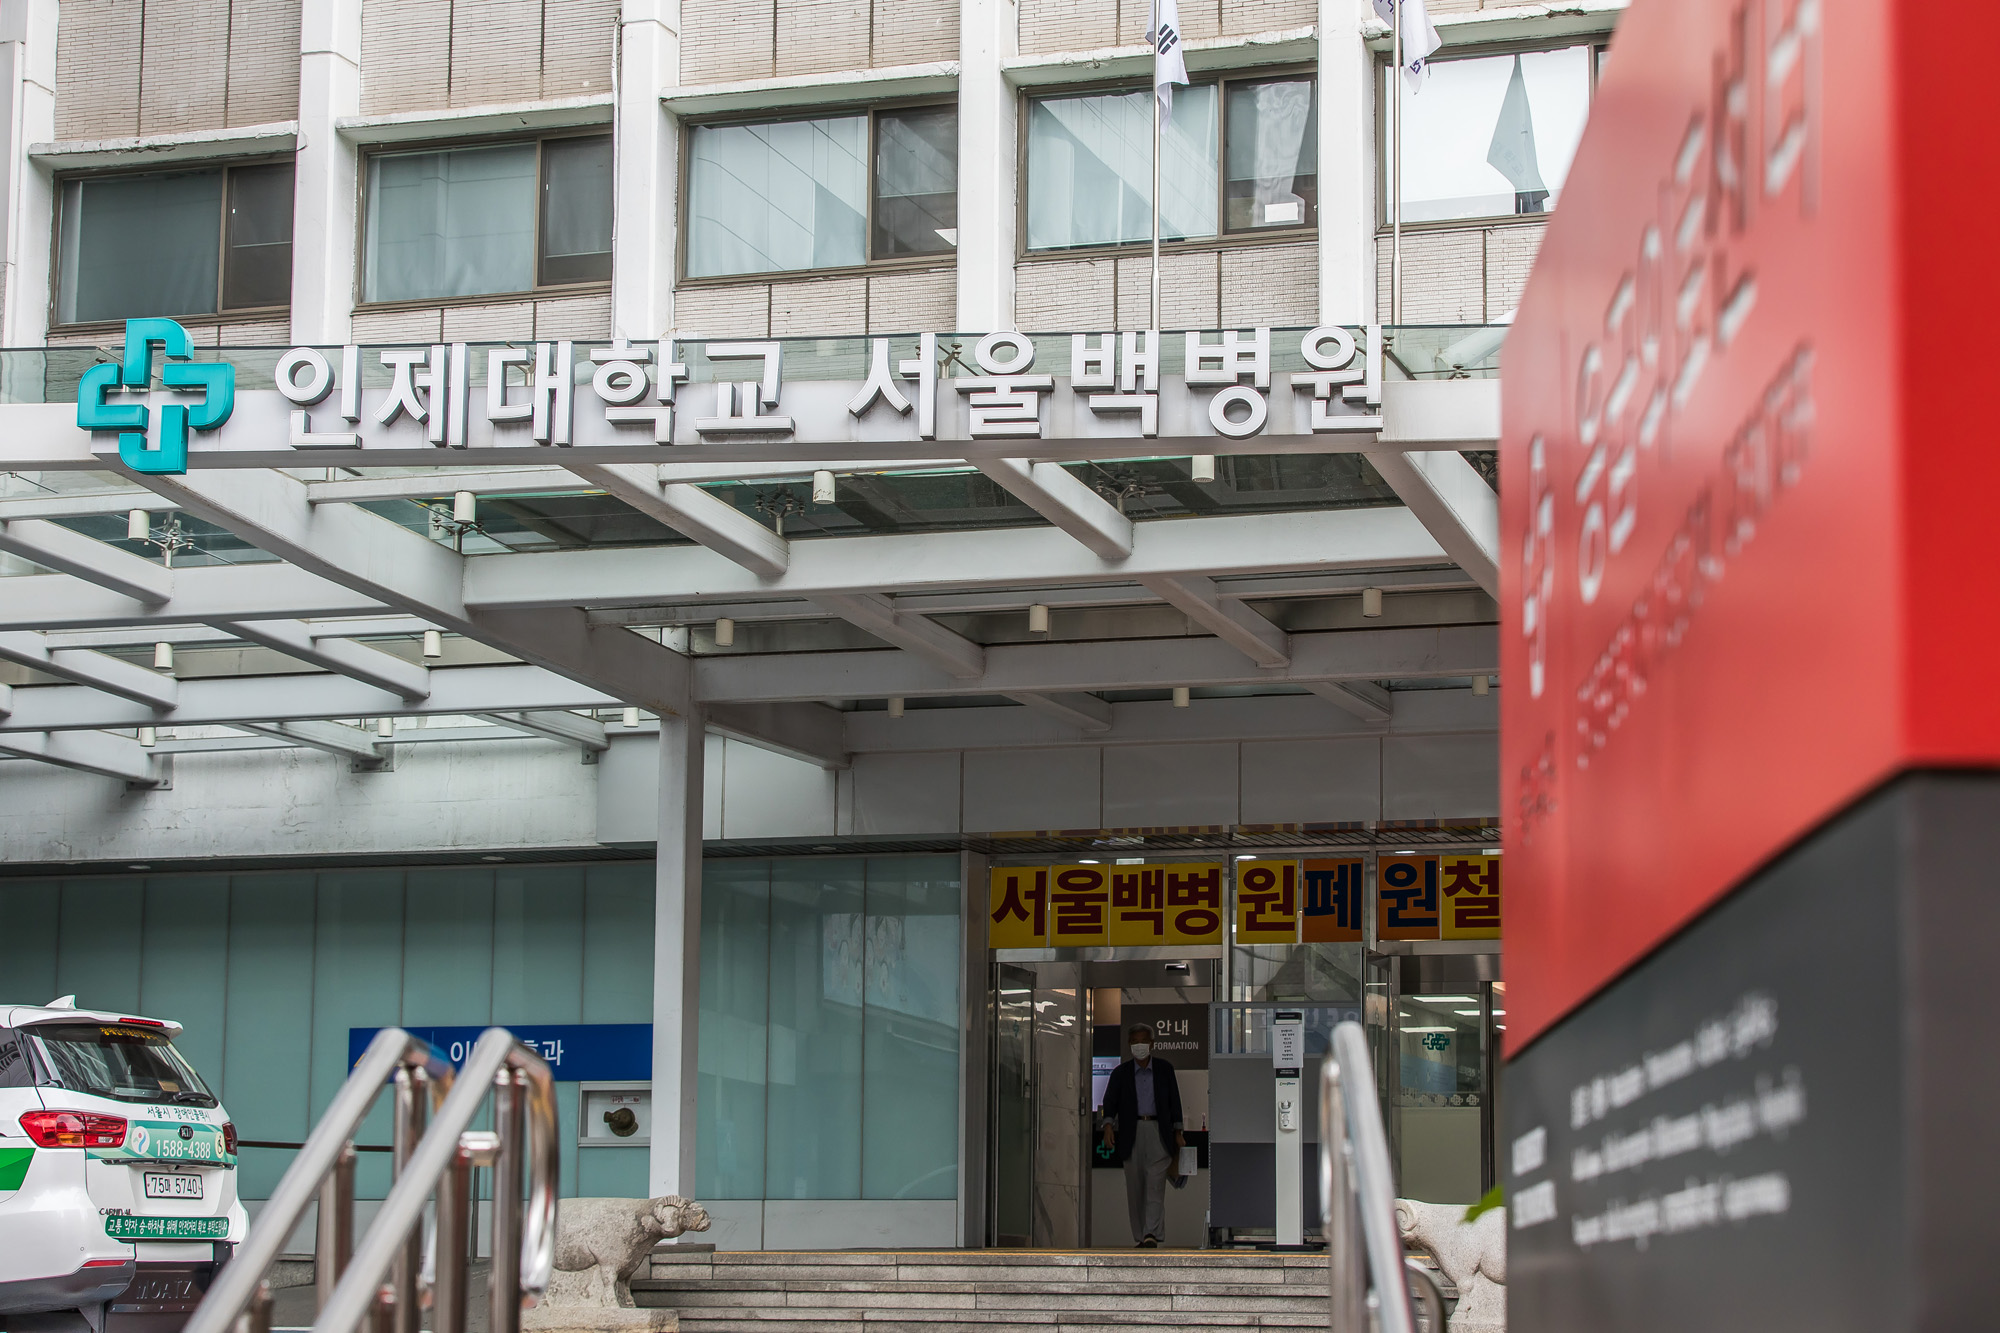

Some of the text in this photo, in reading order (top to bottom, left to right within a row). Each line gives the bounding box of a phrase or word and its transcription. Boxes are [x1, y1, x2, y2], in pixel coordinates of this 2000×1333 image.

[274, 324, 1383, 449] 인제대학교 서울백병원
[991, 865, 1296, 937] 서울백병원
[1156, 1019, 1188, 1036] 안내
[147, 1106, 211, 1122] 서울시 장애인콜택시
[156, 1139, 211, 1159] 1588-4388
[175, 1177, 198, 1195] 5740
[107, 1218, 122, 1234] 교통
[124, 1218, 138, 1234] 약자
[166, 1219, 178, 1235] 위해
[179, 1219, 197, 1235] 안전거리
